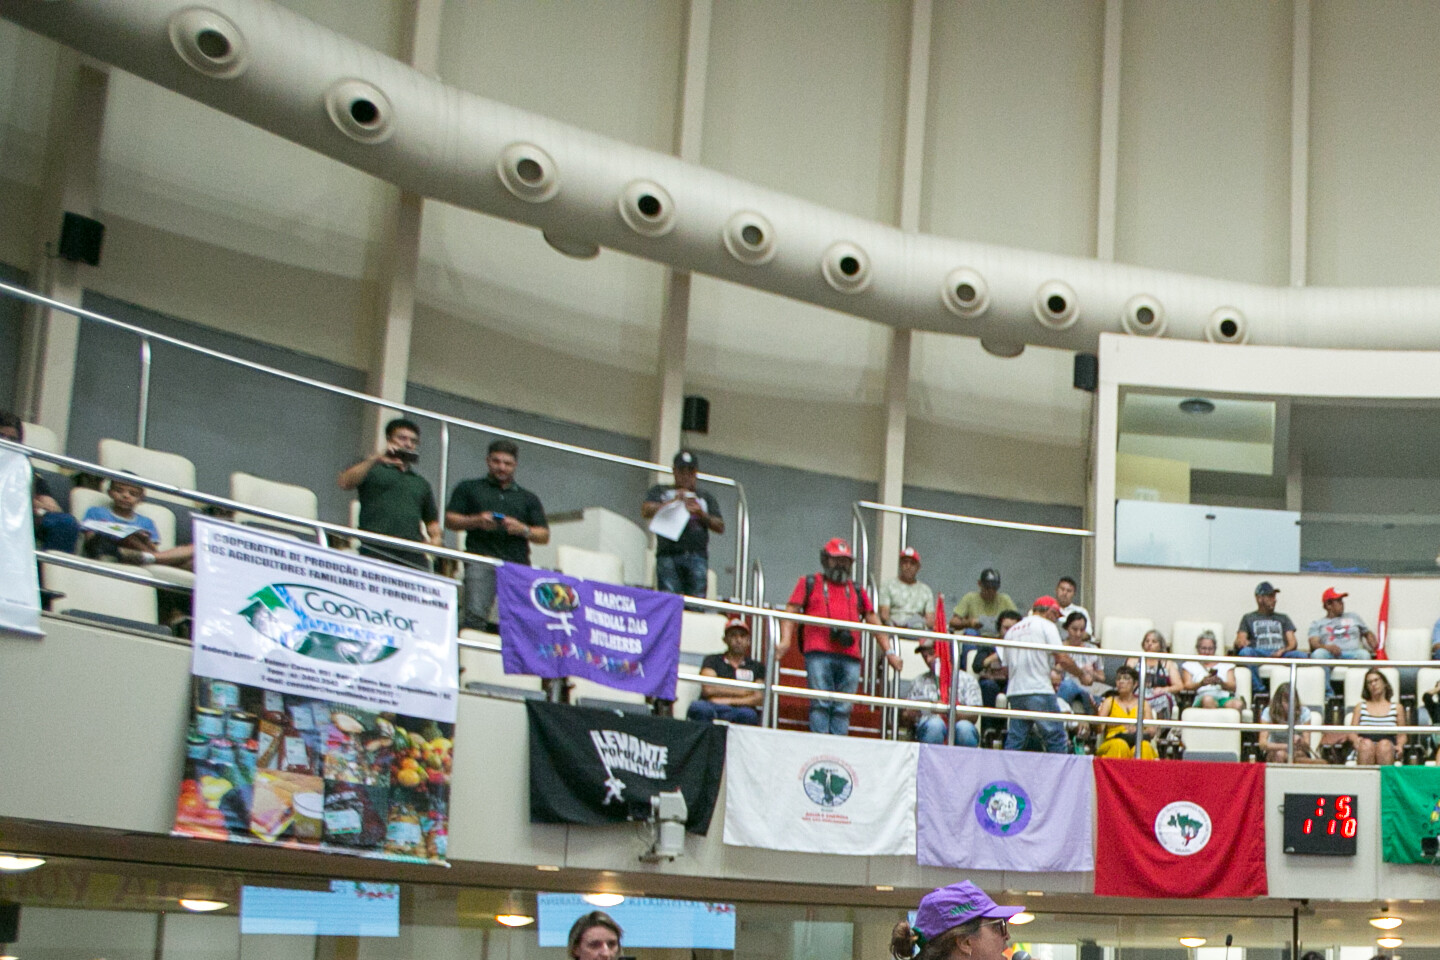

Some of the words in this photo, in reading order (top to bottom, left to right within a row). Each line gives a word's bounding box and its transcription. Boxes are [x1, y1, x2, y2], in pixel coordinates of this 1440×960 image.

[228, 549, 307, 577] AGRICULTORES
[309, 569, 367, 592] FAMILIARES
[304, 591, 419, 632] Coonafor
[593, 589, 637, 614] MARCHA
[584, 605, 626, 632] MUNDIAL
[628, 616, 649, 636] DAS
[589, 628, 643, 655] MULHERES
